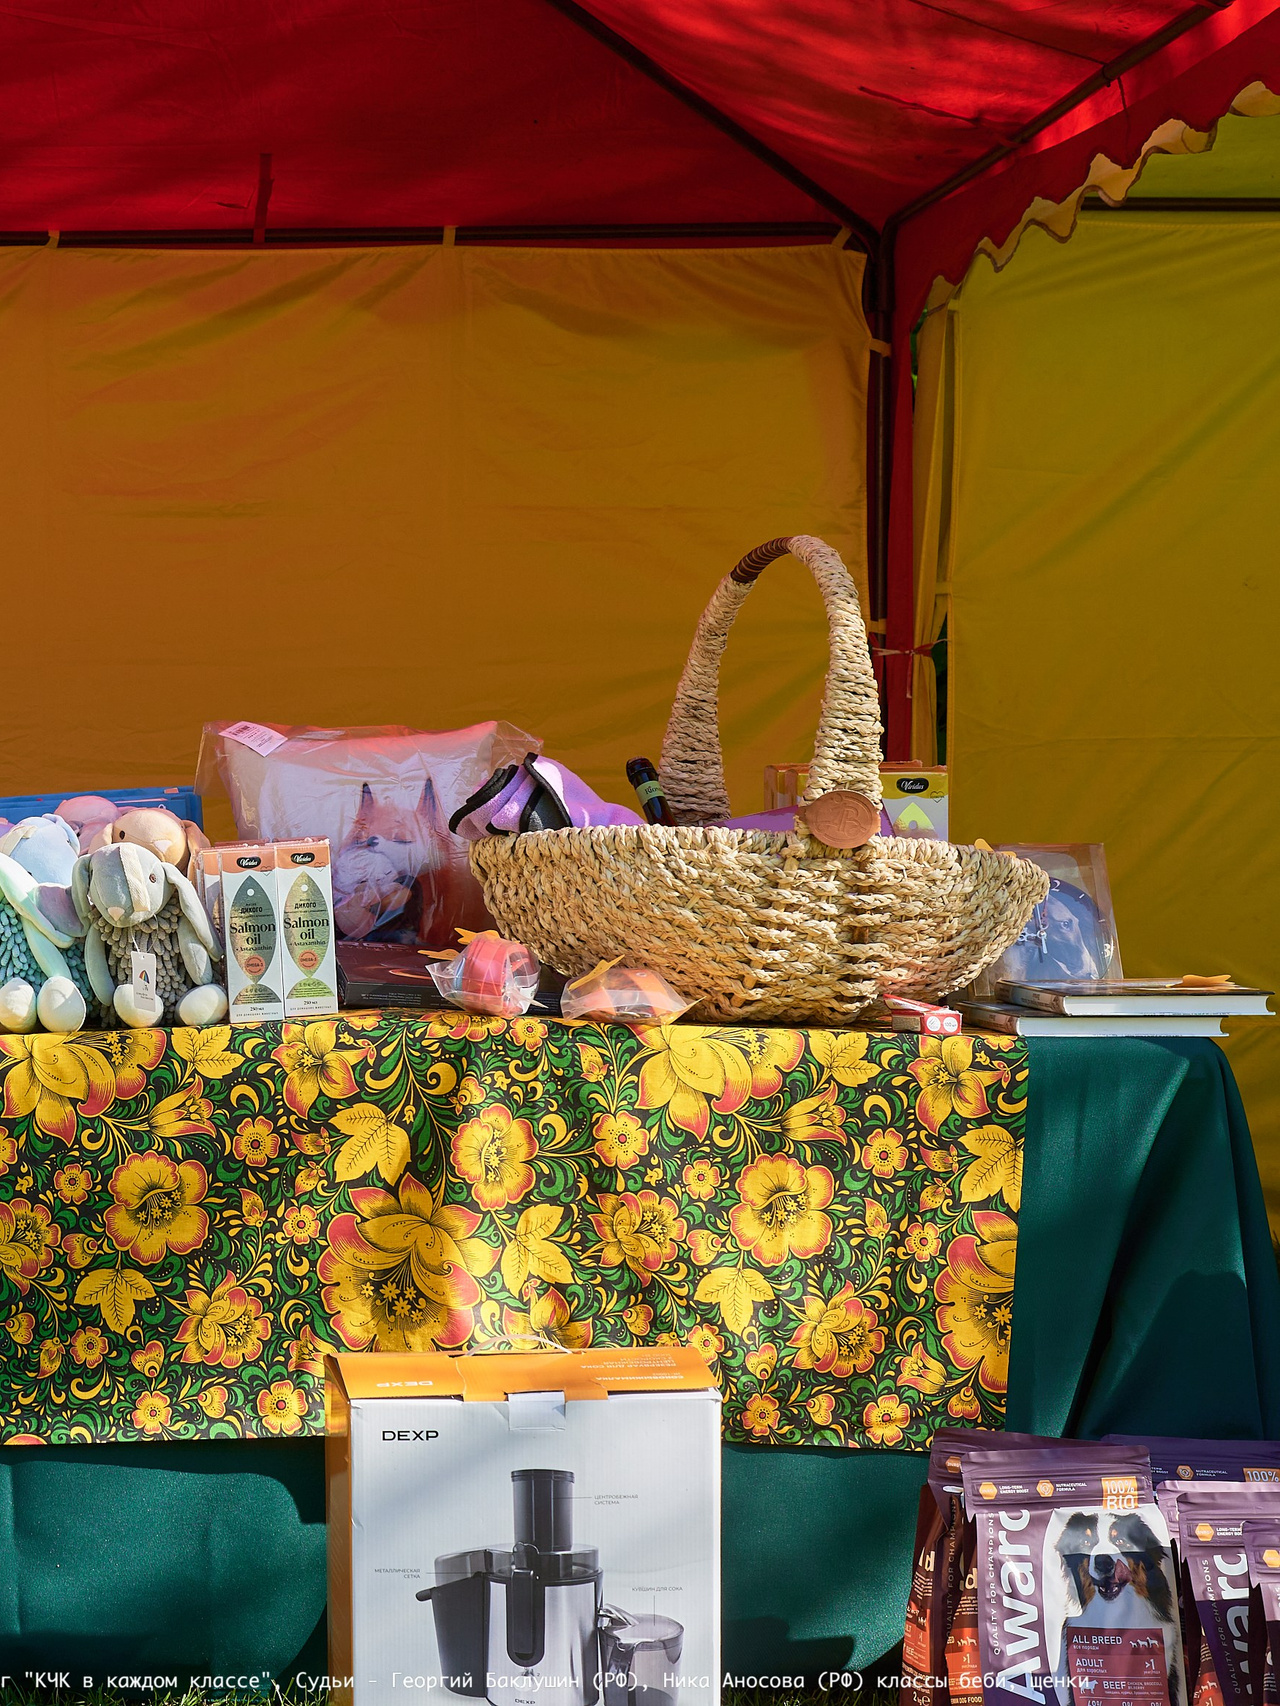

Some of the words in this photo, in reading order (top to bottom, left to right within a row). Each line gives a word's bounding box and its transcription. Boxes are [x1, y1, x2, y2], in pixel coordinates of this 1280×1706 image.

[1051, 880, 1060, 892] 2
[230, 922, 276, 934] Salmon
[284, 917, 330, 929] Salmon
[246, 934, 261, 945] oil
[300, 929, 315, 940] oil
[1104, 943, 1111, 958] 3
[376, 1380, 433, 1388] DEXP
[382, 1430, 439, 1441] DEXP
[1247, 1470, 1279, 1482] 100%
[1104, 1480, 1135, 1495] 100%
[1106, 1496, 1135, 1510] BIO
[988, 1512, 996, 1578] CHAMPIONS
[1201, 1559, 1222, 1623] CHAMPIONS
[991, 1609, 1001, 1655] QUALITY
[1072, 1635, 1089, 1644] ALL
[1092, 1635, 1123, 1645] BREED
[1075, 1658, 1104, 1668] ADULT
[1224, 1651, 1241, 1694] QUALITY
[1103, 1680, 1126, 1690] BEEF
